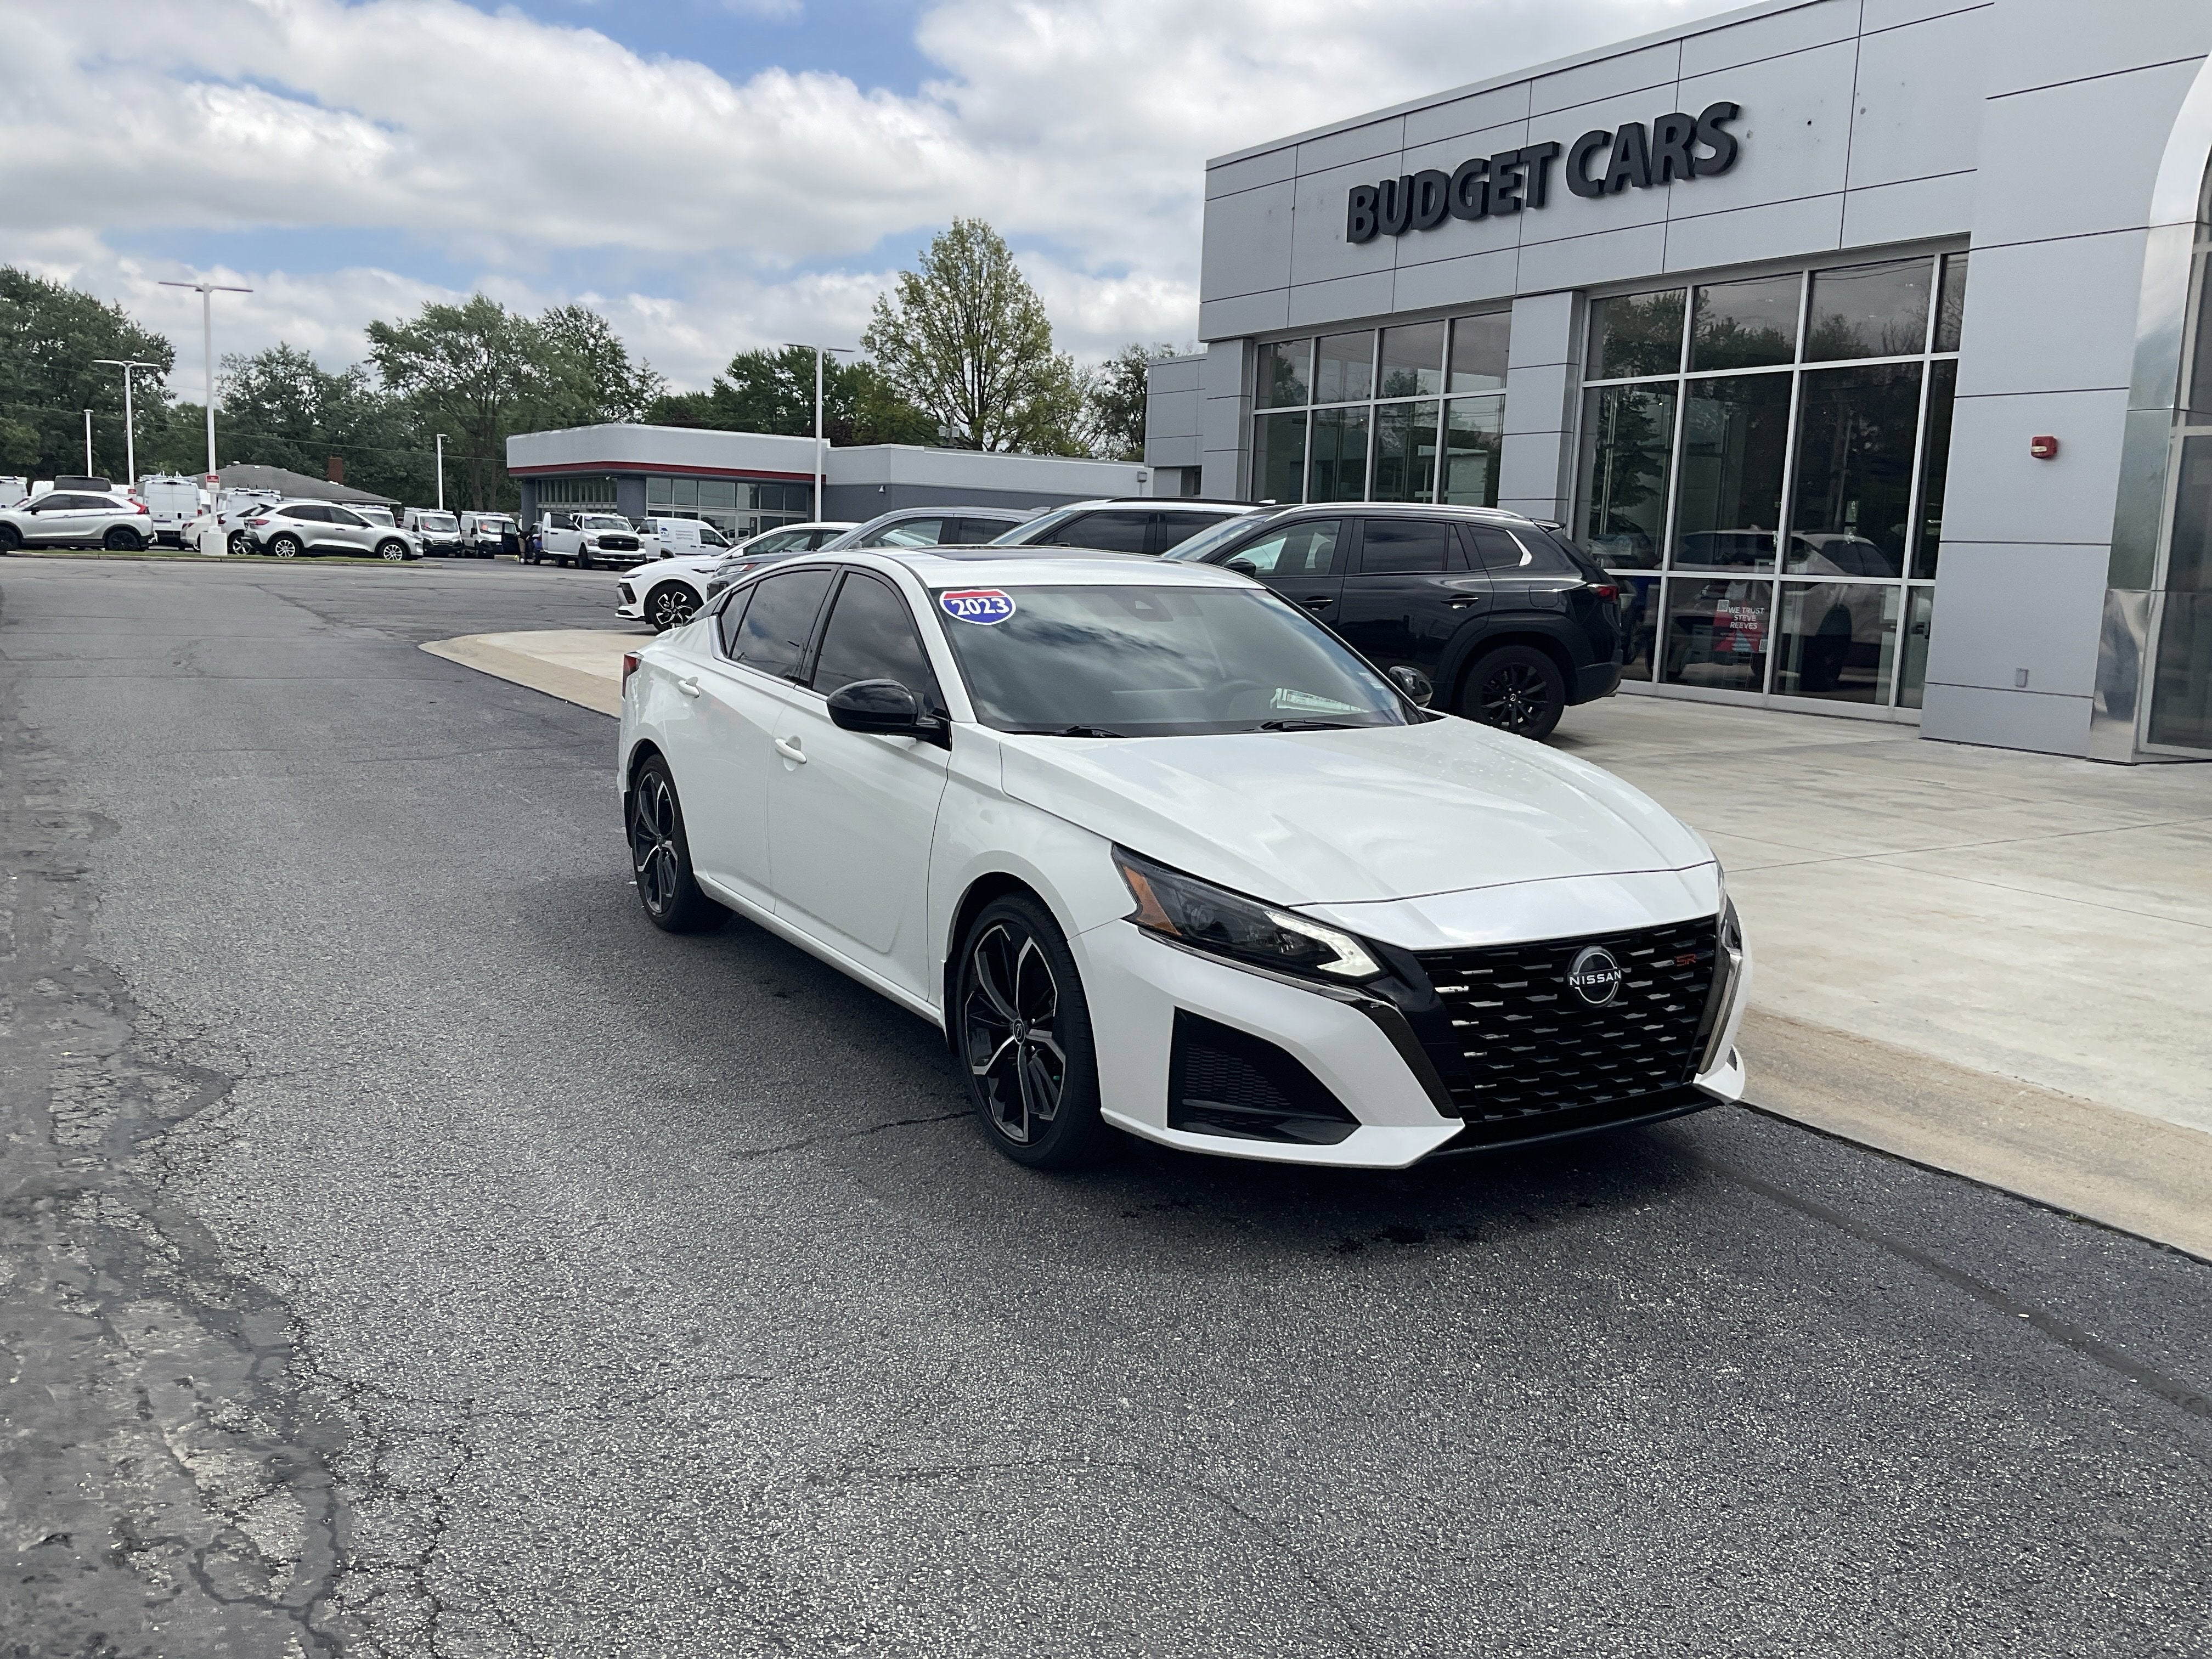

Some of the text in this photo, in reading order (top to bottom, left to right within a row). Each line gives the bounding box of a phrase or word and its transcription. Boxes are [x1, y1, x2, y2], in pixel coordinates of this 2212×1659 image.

[1346, 101, 1740, 244] BUDGET CARS
[951, 597, 1009, 616] 2023
[1675, 953, 1697, 967] SR
[1569, 970, 1622, 986] NISSAN
